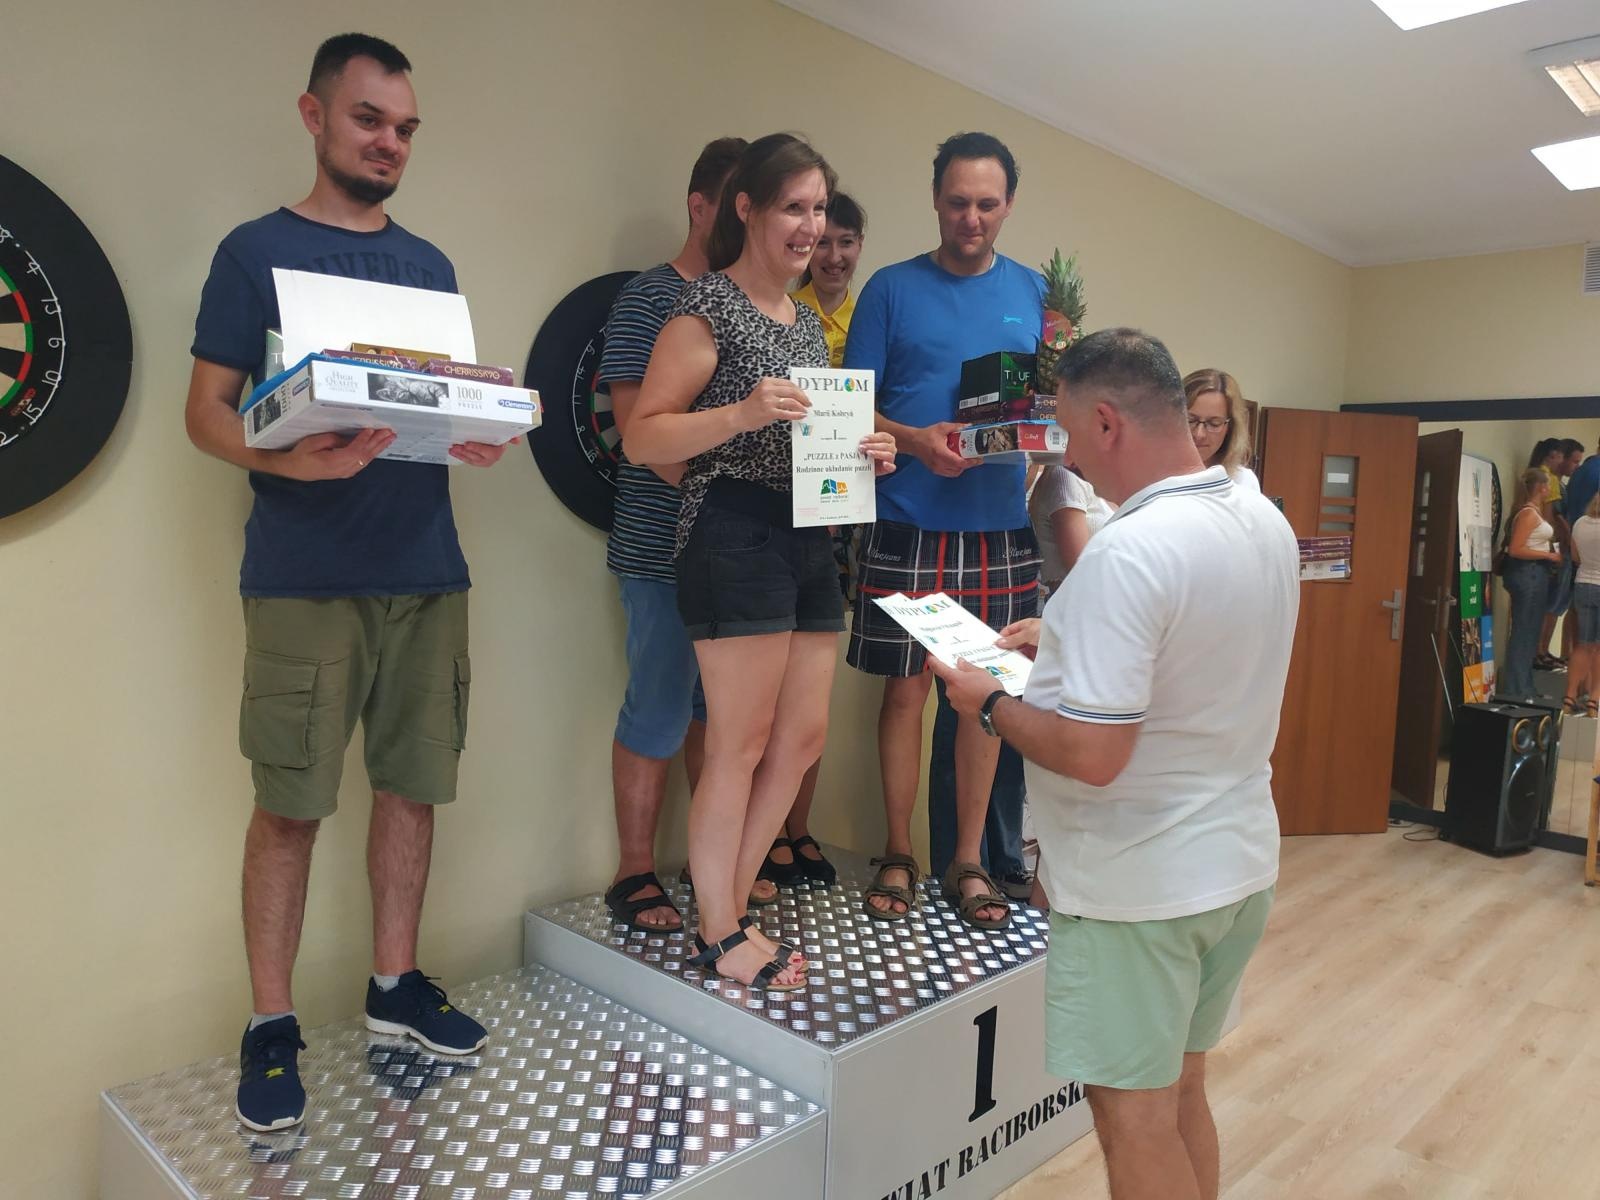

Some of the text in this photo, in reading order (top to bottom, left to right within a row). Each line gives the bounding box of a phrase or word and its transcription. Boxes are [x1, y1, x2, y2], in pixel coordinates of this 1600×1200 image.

[41, 297, 62, 315] 13
[341, 356, 404, 369] RRISSIMO
[42, 370, 61, 388] 10
[444, 365, 500, 380] CHERRISSIMO
[456, 385, 483, 401] 1000
[797, 377, 870, 392] DYPLOM
[22, 403, 43, 423] 15
[967, 1004, 998, 1123] 1
[880, 1080, 1088, 1200] IAT RACIBORSK
